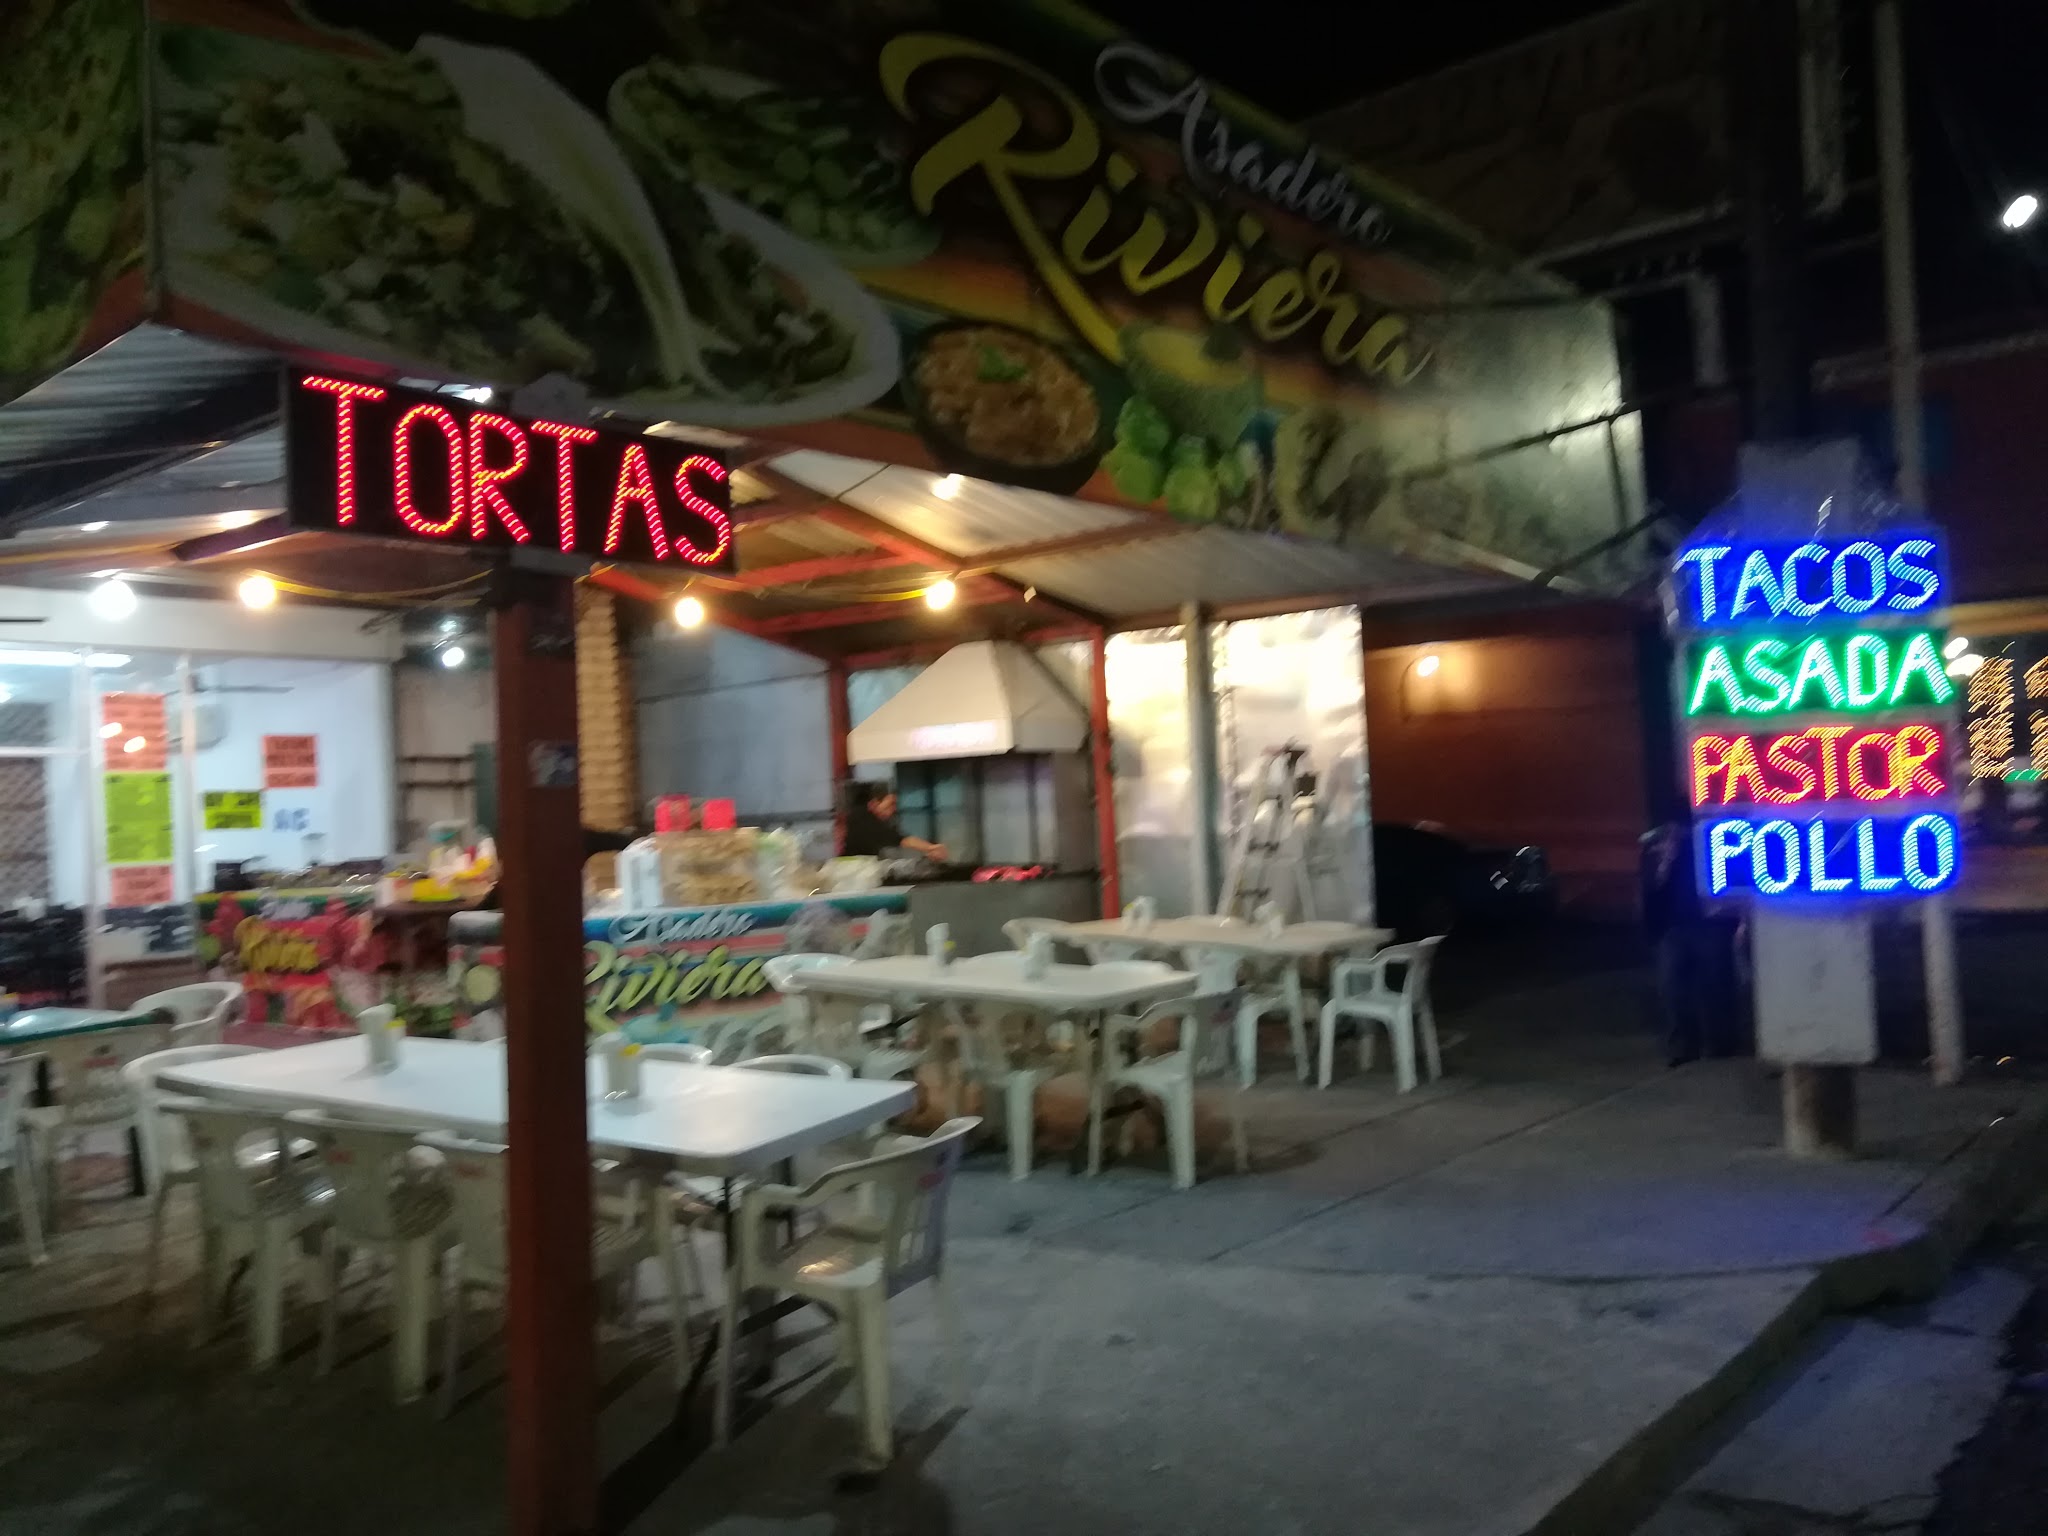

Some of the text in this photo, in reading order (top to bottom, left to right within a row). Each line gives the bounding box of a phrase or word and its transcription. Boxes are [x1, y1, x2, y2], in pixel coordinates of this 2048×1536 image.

[878, 30, 1435, 389] Riviera
[302, 375, 732, 565] TORTAS
[1682, 540, 1940, 622] TACOS
[1687, 632, 1955, 716] ASADA
[1692, 725, 1945, 808] PASTOR
[1709, 813, 1955, 895] POLLO
